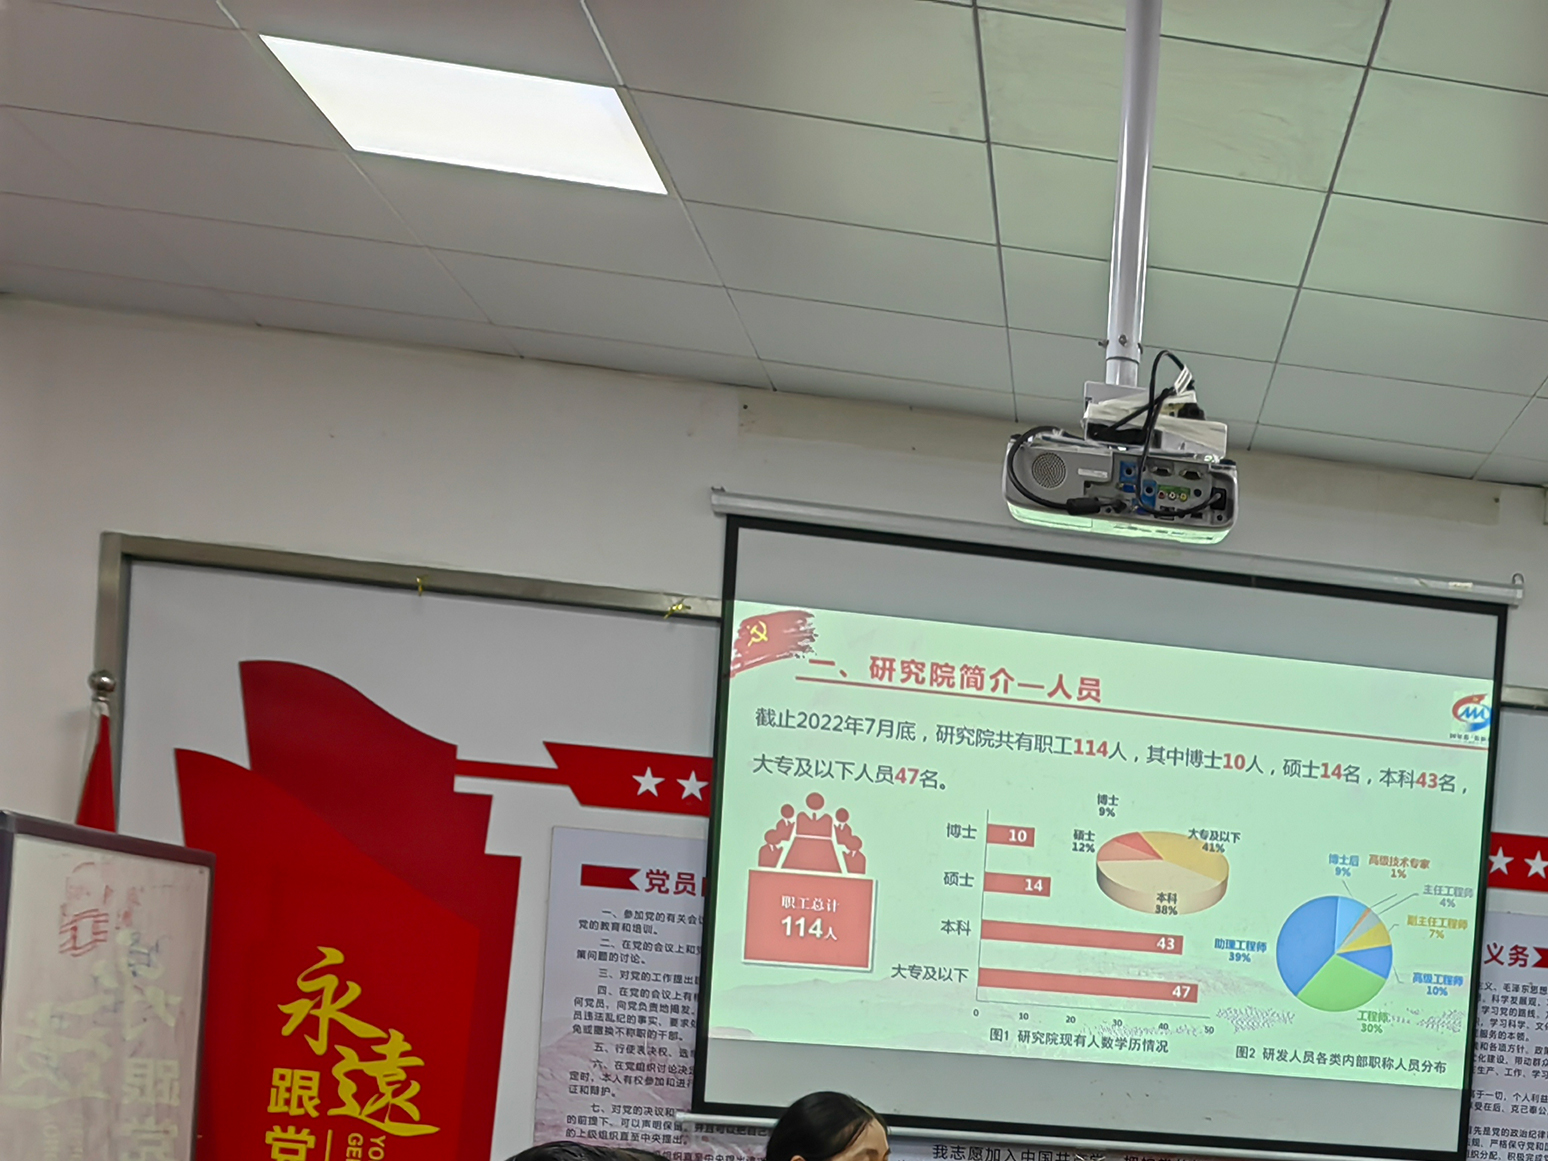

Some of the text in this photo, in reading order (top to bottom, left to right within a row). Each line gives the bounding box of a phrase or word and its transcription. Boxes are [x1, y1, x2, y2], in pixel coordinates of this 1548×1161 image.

[808, 654, 1103, 705] 一、研究院简介—人员
[752, 754, 950, 792] 大专及以下人员47名。
[1097, 794, 1119, 807] 博士
[1098, 805, 1116, 818] 9%
[946, 823, 978, 841] 博士
[1009, 828, 1027, 843] 10
[1073, 829, 1096, 843] 硕士
[1188, 828, 1241, 845] 大专及以下
[1071, 841, 1096, 853] 12%
[1202, 841, 1225, 854] 41%
[1328, 853, 1359, 867] 博士后
[1335, 866, 1351, 878] 9%
[1391, 868, 1407, 880] 1%
[644, 869, 707, 896] 党员
[943, 871, 974, 890] 硕士
[1024, 878, 1043, 893] 14
[781, 894, 840, 913] 职工总计
[1156, 892, 1178, 905] 本科
[1440, 896, 1456, 908] 4%
[1154, 904, 1178, 916] 38%
[780, 915, 838, 942] 114人
[940, 918, 972, 937] 本科
[1428, 928, 1444, 940] 7%
[1156, 936, 1176, 952] 43
[1215, 938, 1268, 954] 助理工程师
[1229, 951, 1251, 963] 39%
[1484, 942, 1529, 968] 义务
[891, 962, 969, 983] 大专及以下
[597, 985, 700, 1003] 四、在党的会议上有
[1172, 983, 1191, 1000] 47
[1426, 984, 1448, 997] 10%
[973, 1007, 980, 1018] 0
[1018, 1011, 1030, 1022] 10
[1357, 1009, 1389, 1025] 工程师
[1065, 1015, 1076, 1025] 20
[1111, 1017, 1123, 1028] 30
[1158, 1021, 1169, 1032] 40
[1203, 1025, 1215, 1035] 50
[1361, 1023, 1383, 1035] 30%
[1475, 1029, 1530, 1042] 服务的本领。
[989, 1027, 1169, 1054] 图1 研究院现有人数学历情况
[593, 1043, 696, 1060] 五、行使表决权、选
[1235, 1044, 1447, 1076] 图2 研发人员各类内部职称人员分布
